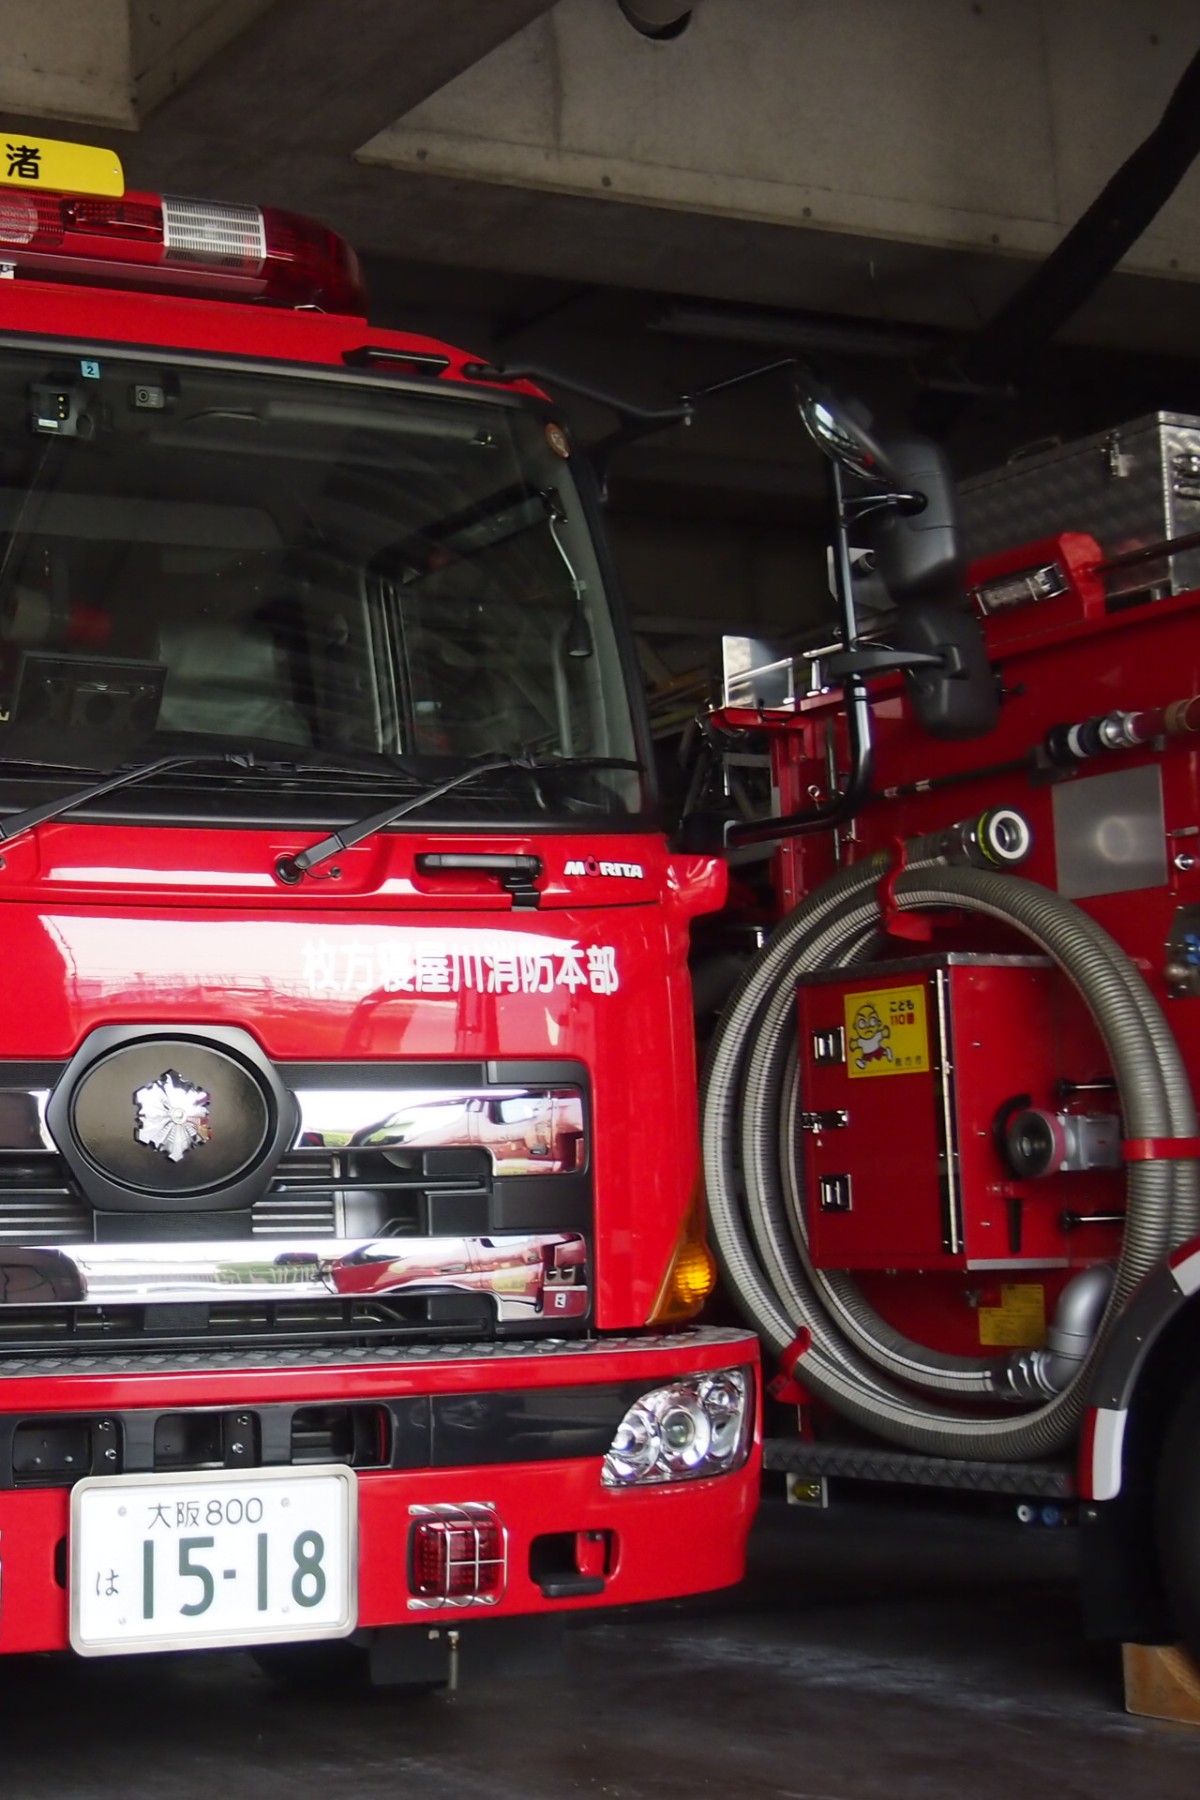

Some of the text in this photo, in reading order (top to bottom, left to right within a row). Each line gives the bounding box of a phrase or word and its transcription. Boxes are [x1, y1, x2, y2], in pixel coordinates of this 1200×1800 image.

[6, 143, 42, 179] 渚
[86, 365, 96, 376] 2
[563, 856, 644, 879] MORITA
[147, 1497, 264, 1530] 大阪800
[95, 1529, 327, 1620] は 15-18
